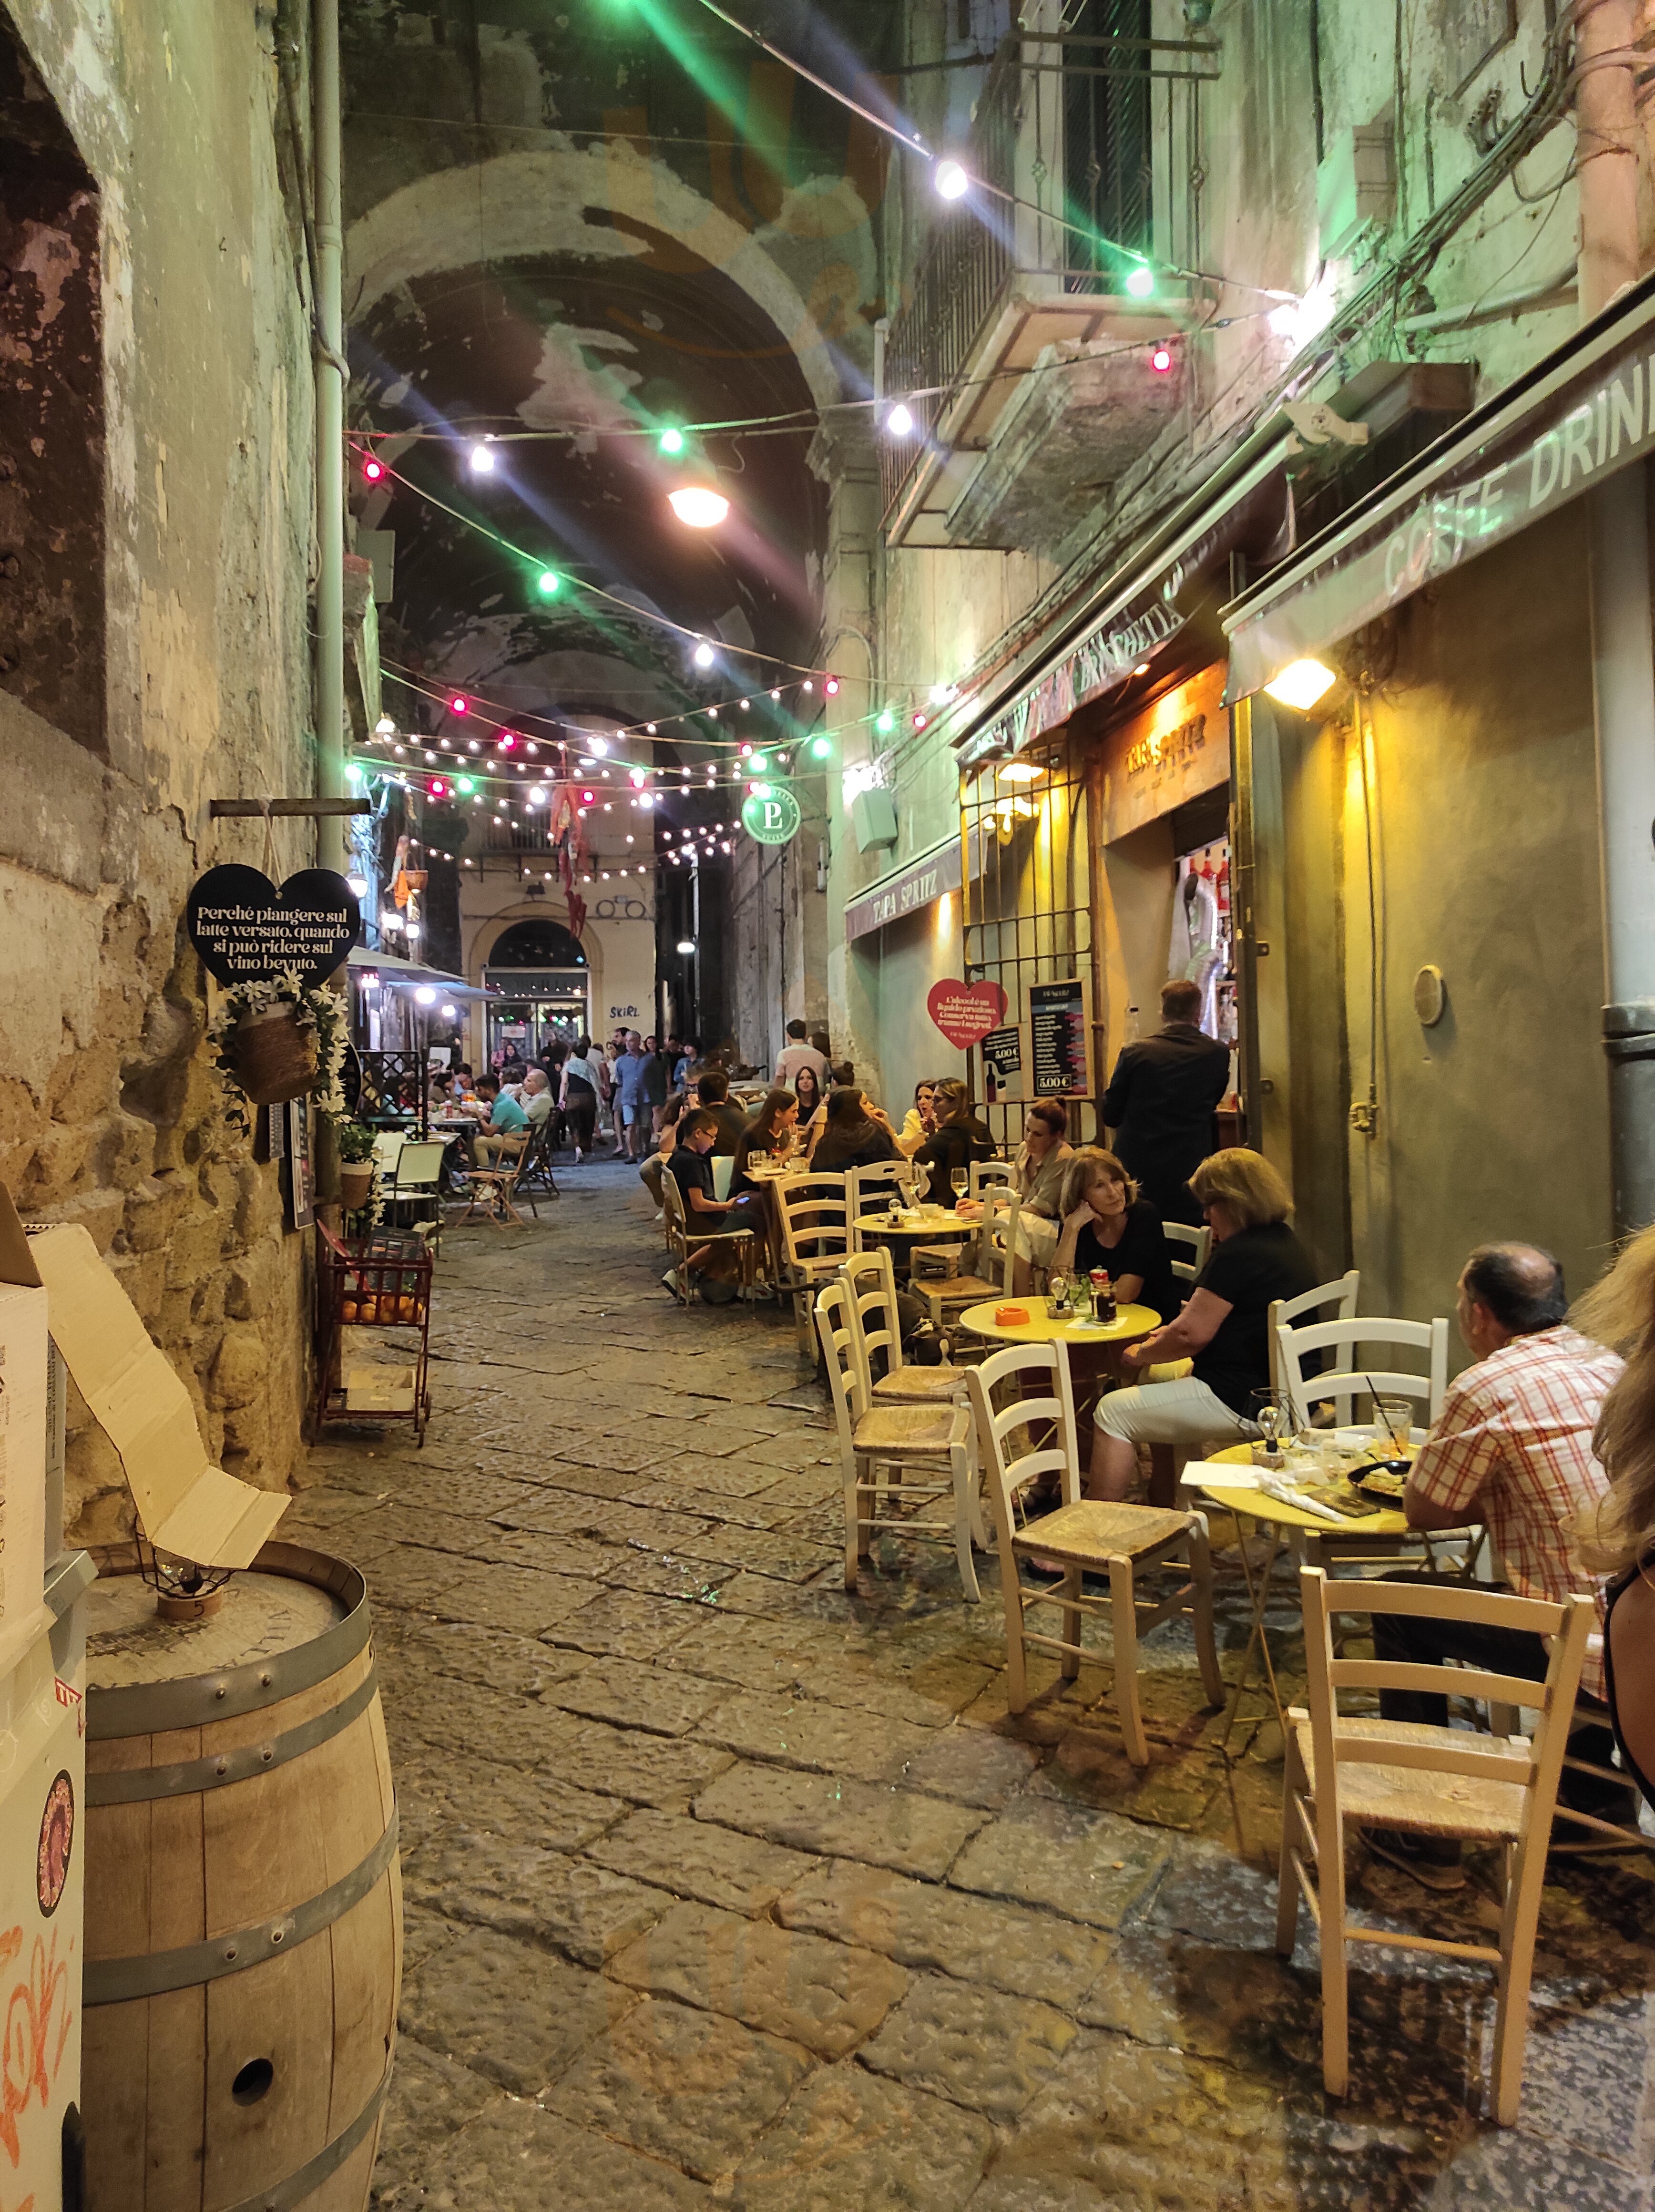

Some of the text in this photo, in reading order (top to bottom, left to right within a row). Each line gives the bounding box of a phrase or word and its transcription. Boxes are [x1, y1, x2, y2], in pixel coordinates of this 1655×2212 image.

[872, 868, 938, 924] TAPA SPRITZ
[197, 904, 347, 926] Perché piangere sul
[196, 920, 230, 936] latte
[294, 923, 350, 941] quando
[212, 938, 333, 957] si può ridere sul
[226, 954, 318, 970] vino bevuto.
[1061, 1076, 1069, 1087] €
[194, 1600, 205, 1617] 5
